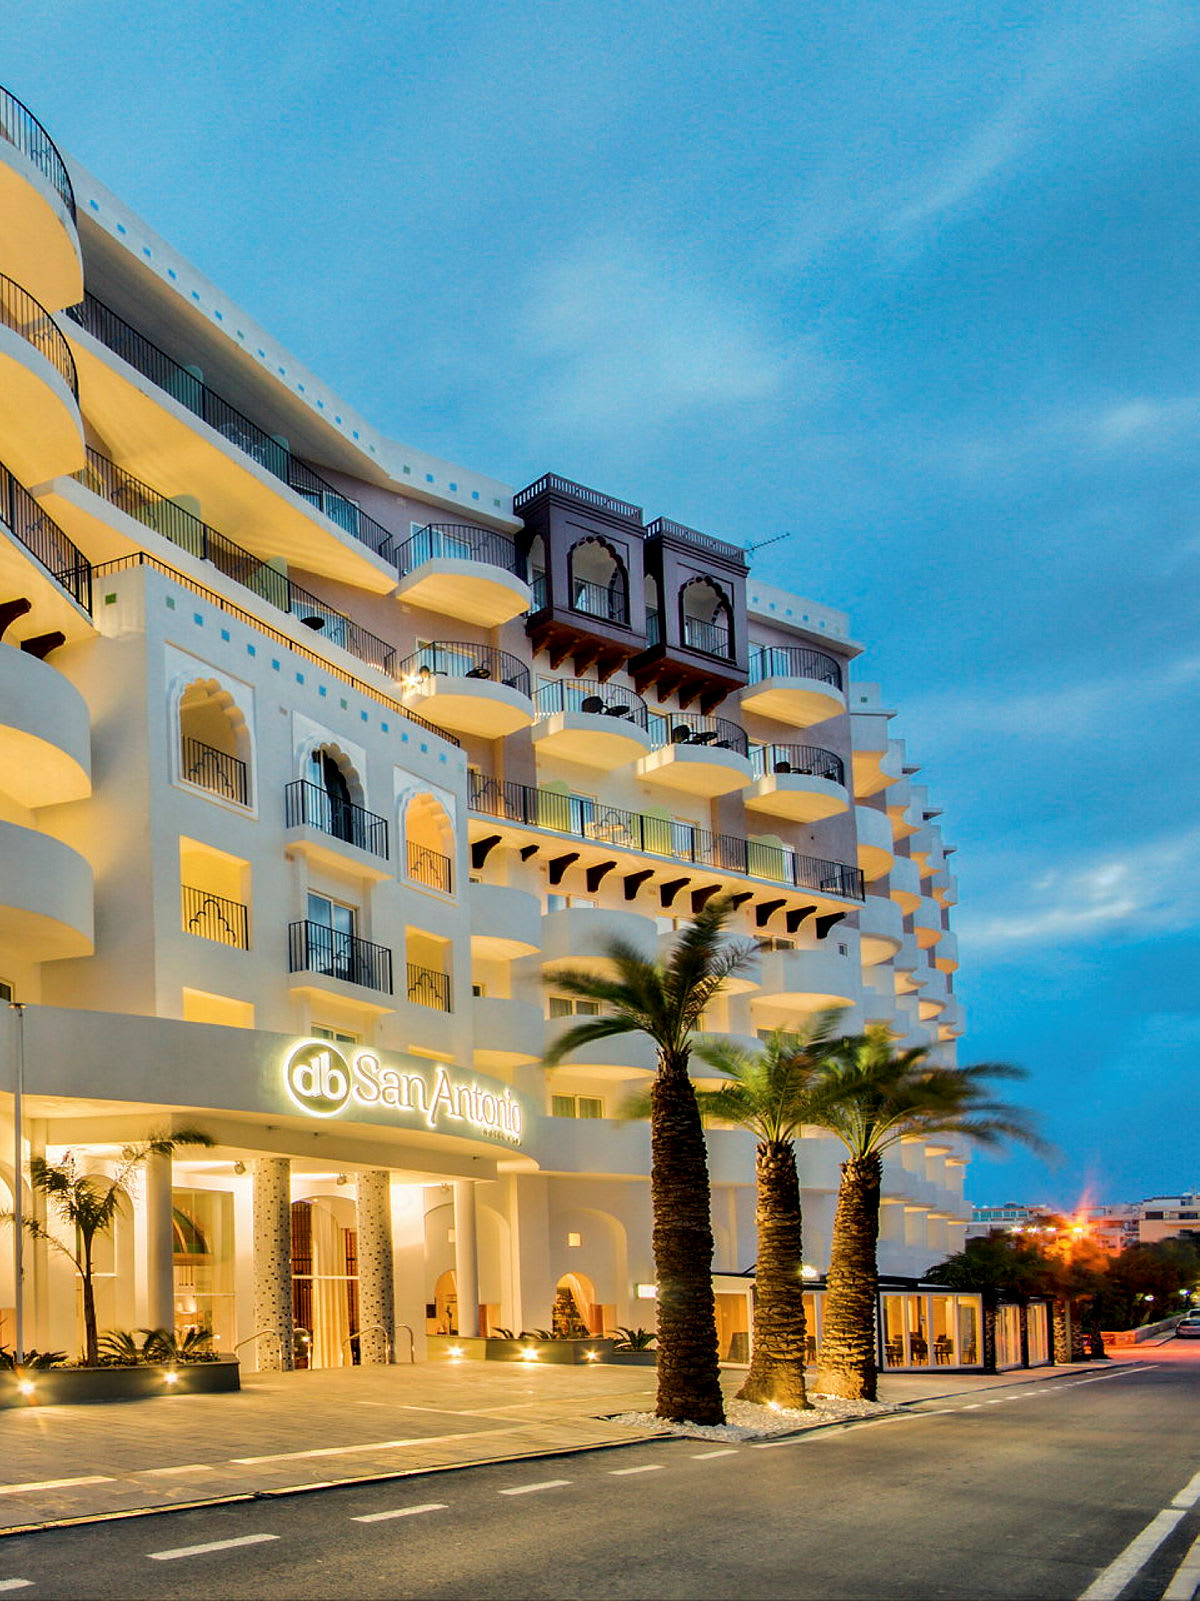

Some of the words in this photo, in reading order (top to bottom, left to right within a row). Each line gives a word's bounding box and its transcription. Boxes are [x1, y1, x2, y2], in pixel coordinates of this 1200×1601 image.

[291, 1051, 349, 1101] db
[353, 1052, 429, 1112] San
[427, 1067, 522, 1134] Antonio
